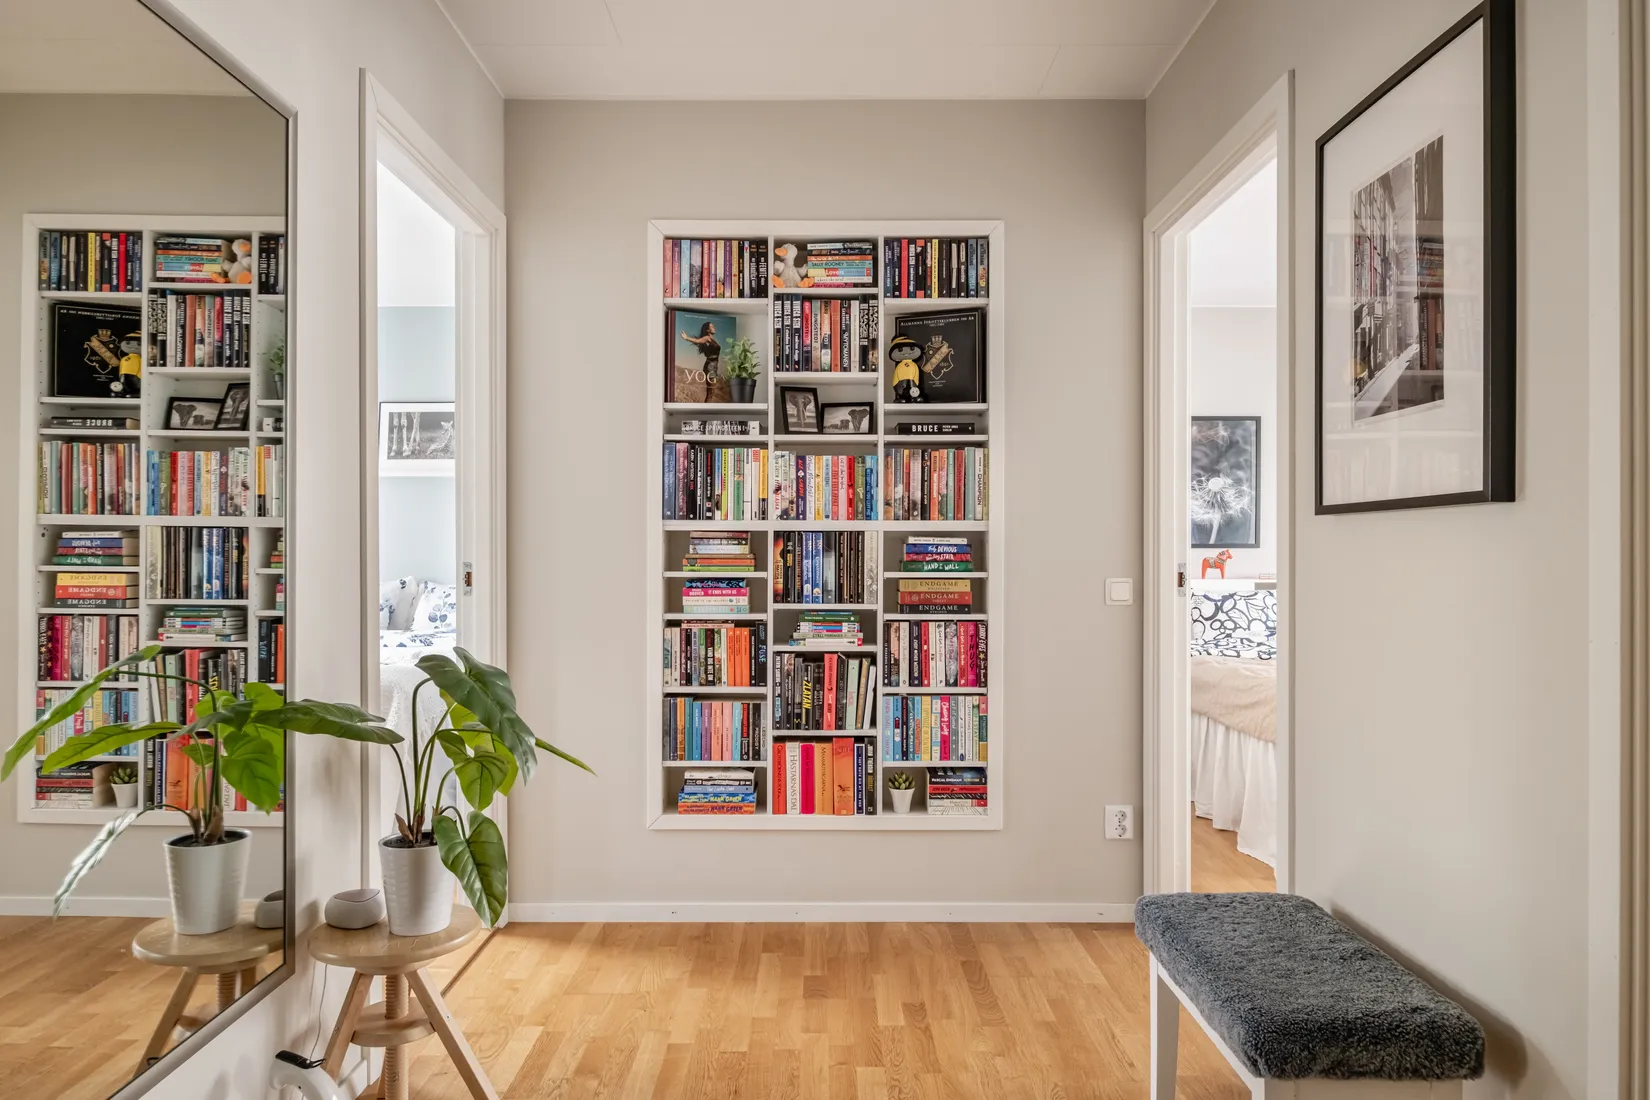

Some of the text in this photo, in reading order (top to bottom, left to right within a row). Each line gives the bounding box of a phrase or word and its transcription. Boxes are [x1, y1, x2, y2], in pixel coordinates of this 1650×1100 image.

[803, 681, 811, 709] ZLATAN
[941, 702, 949, 736] Chasing Lucky
[790, 798, 798, 811] DAL
